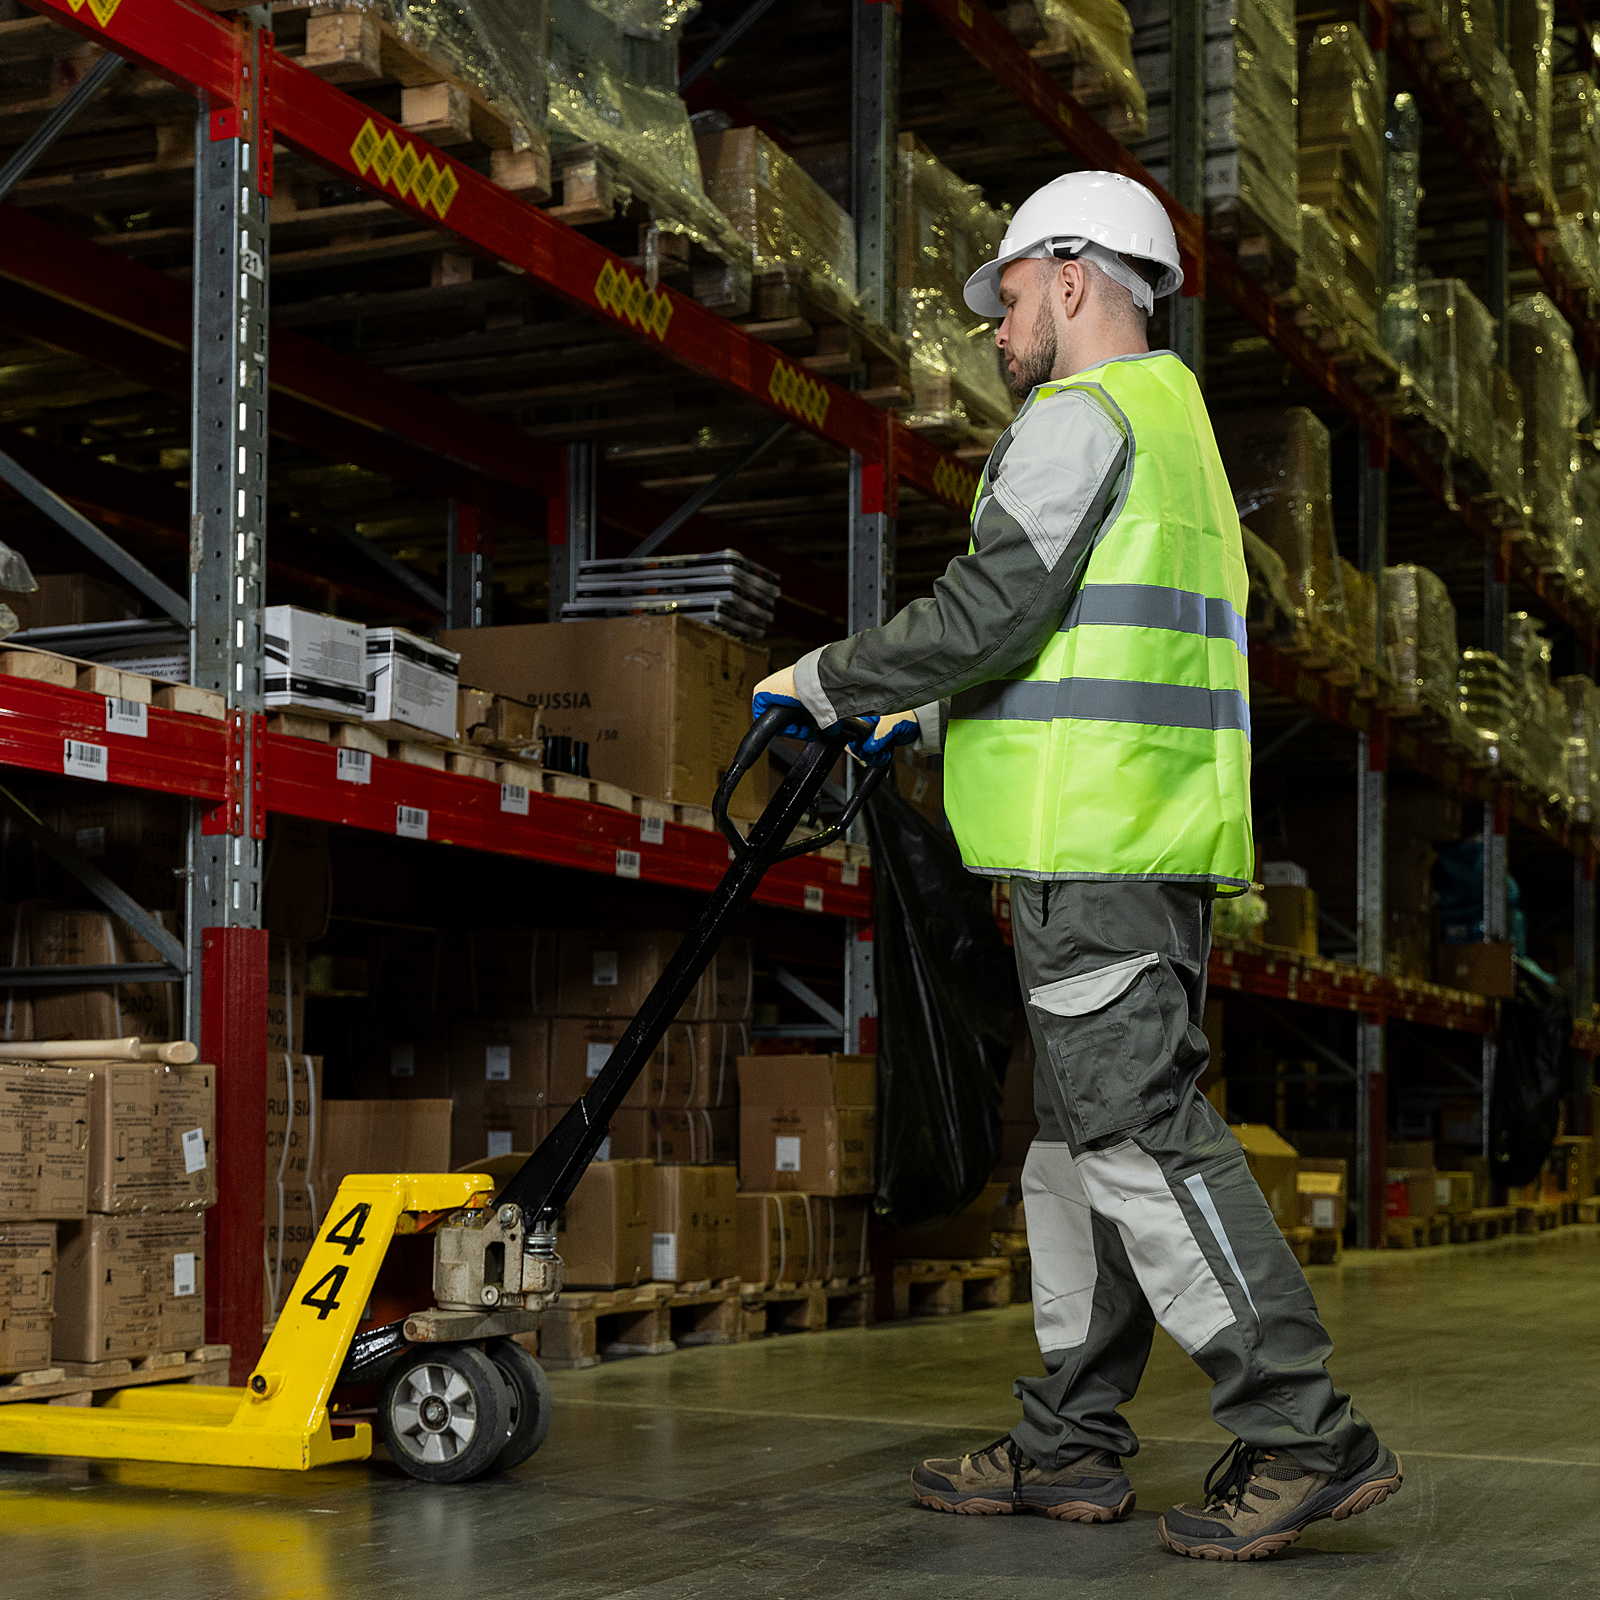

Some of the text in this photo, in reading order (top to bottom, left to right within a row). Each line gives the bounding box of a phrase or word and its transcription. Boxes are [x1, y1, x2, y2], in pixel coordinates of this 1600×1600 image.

[244, 253, 258, 272] 21
[527, 692, 591, 709] RUSSIA
[267, 1098, 310, 1116] RUSI
[269, 1225, 314, 1243] RSSIA
[325, 1203, 372, 1256] 4
[301, 1265, 349, 1320] 4
